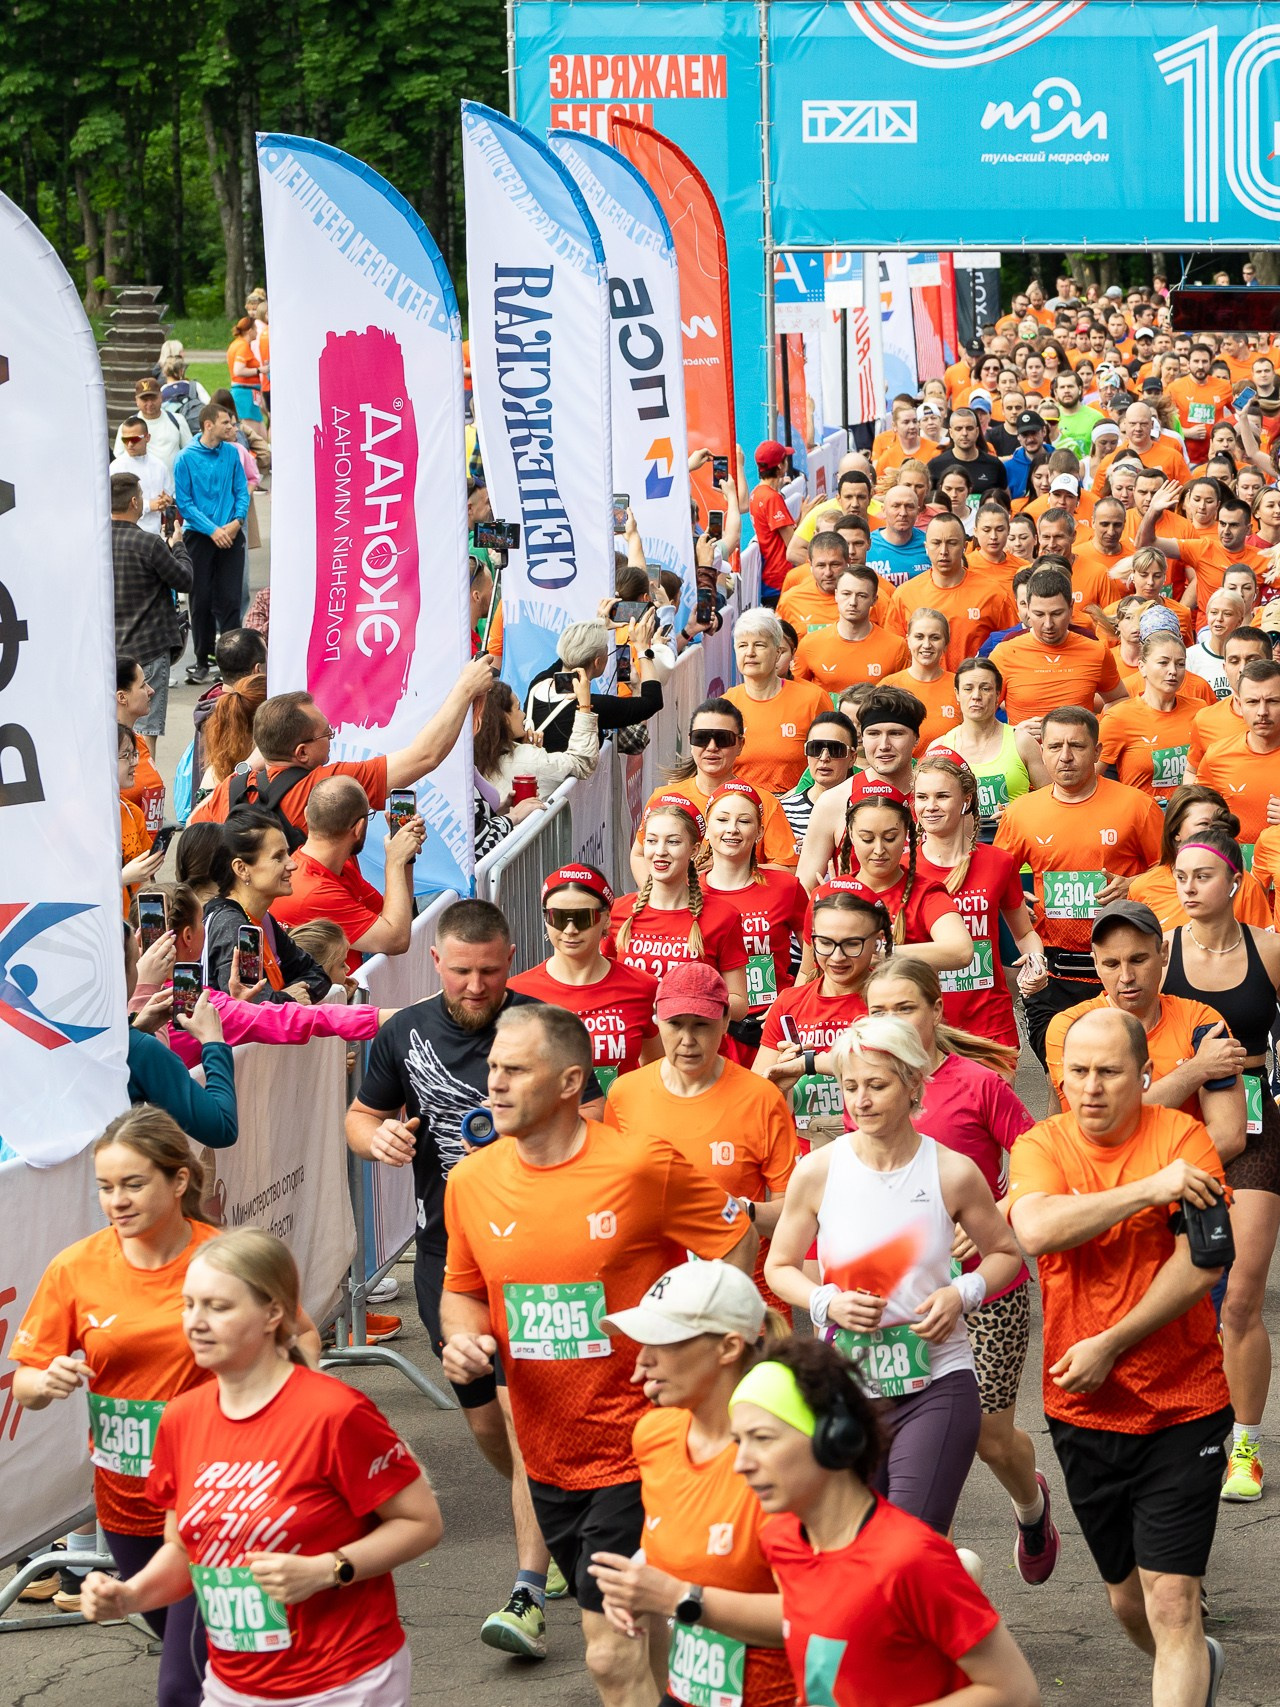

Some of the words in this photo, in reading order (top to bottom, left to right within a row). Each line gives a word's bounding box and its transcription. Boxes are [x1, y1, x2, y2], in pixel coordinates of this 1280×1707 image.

[549, 54, 727, 98] ЗАРЯЖАЕМ
[550, 104, 653, 138] БЕГМ
[981, 151, 1045, 165] тульский
[1048, 151, 1109, 165] марафон
[780, 723, 796, 737] 10
[1162, 754, 1188, 778] 208
[724, 783, 753, 793] ГОРДОСТЬ
[862, 785, 893, 795] ГОРДОСТЬ
[979, 785, 997, 807] 61
[661, 795, 691, 806] ГОРДОСТЬ
[1099, 828, 1118, 846] 10
[559, 870, 592, 881] ГОРДОСТЬ
[830, 880, 863, 891] ГОРДОСТЬ
[1053, 882, 1096, 907] 2304
[805, 1082, 844, 1113] 255
[709, 1141, 735, 1165] 10
[232, 1181, 281, 1227] Министерство
[282, 1165, 305, 1198] спорта
[267, 1212, 294, 1239] бласти
[587, 1210, 617, 1240] 10
[650, 1276, 672, 1299] R
[521, 1300, 589, 1340] 2295
[99, 1413, 151, 1458] 2361
[203, 1586, 266, 1630] 2076
[672, 1627, 726, 1689] 2026
